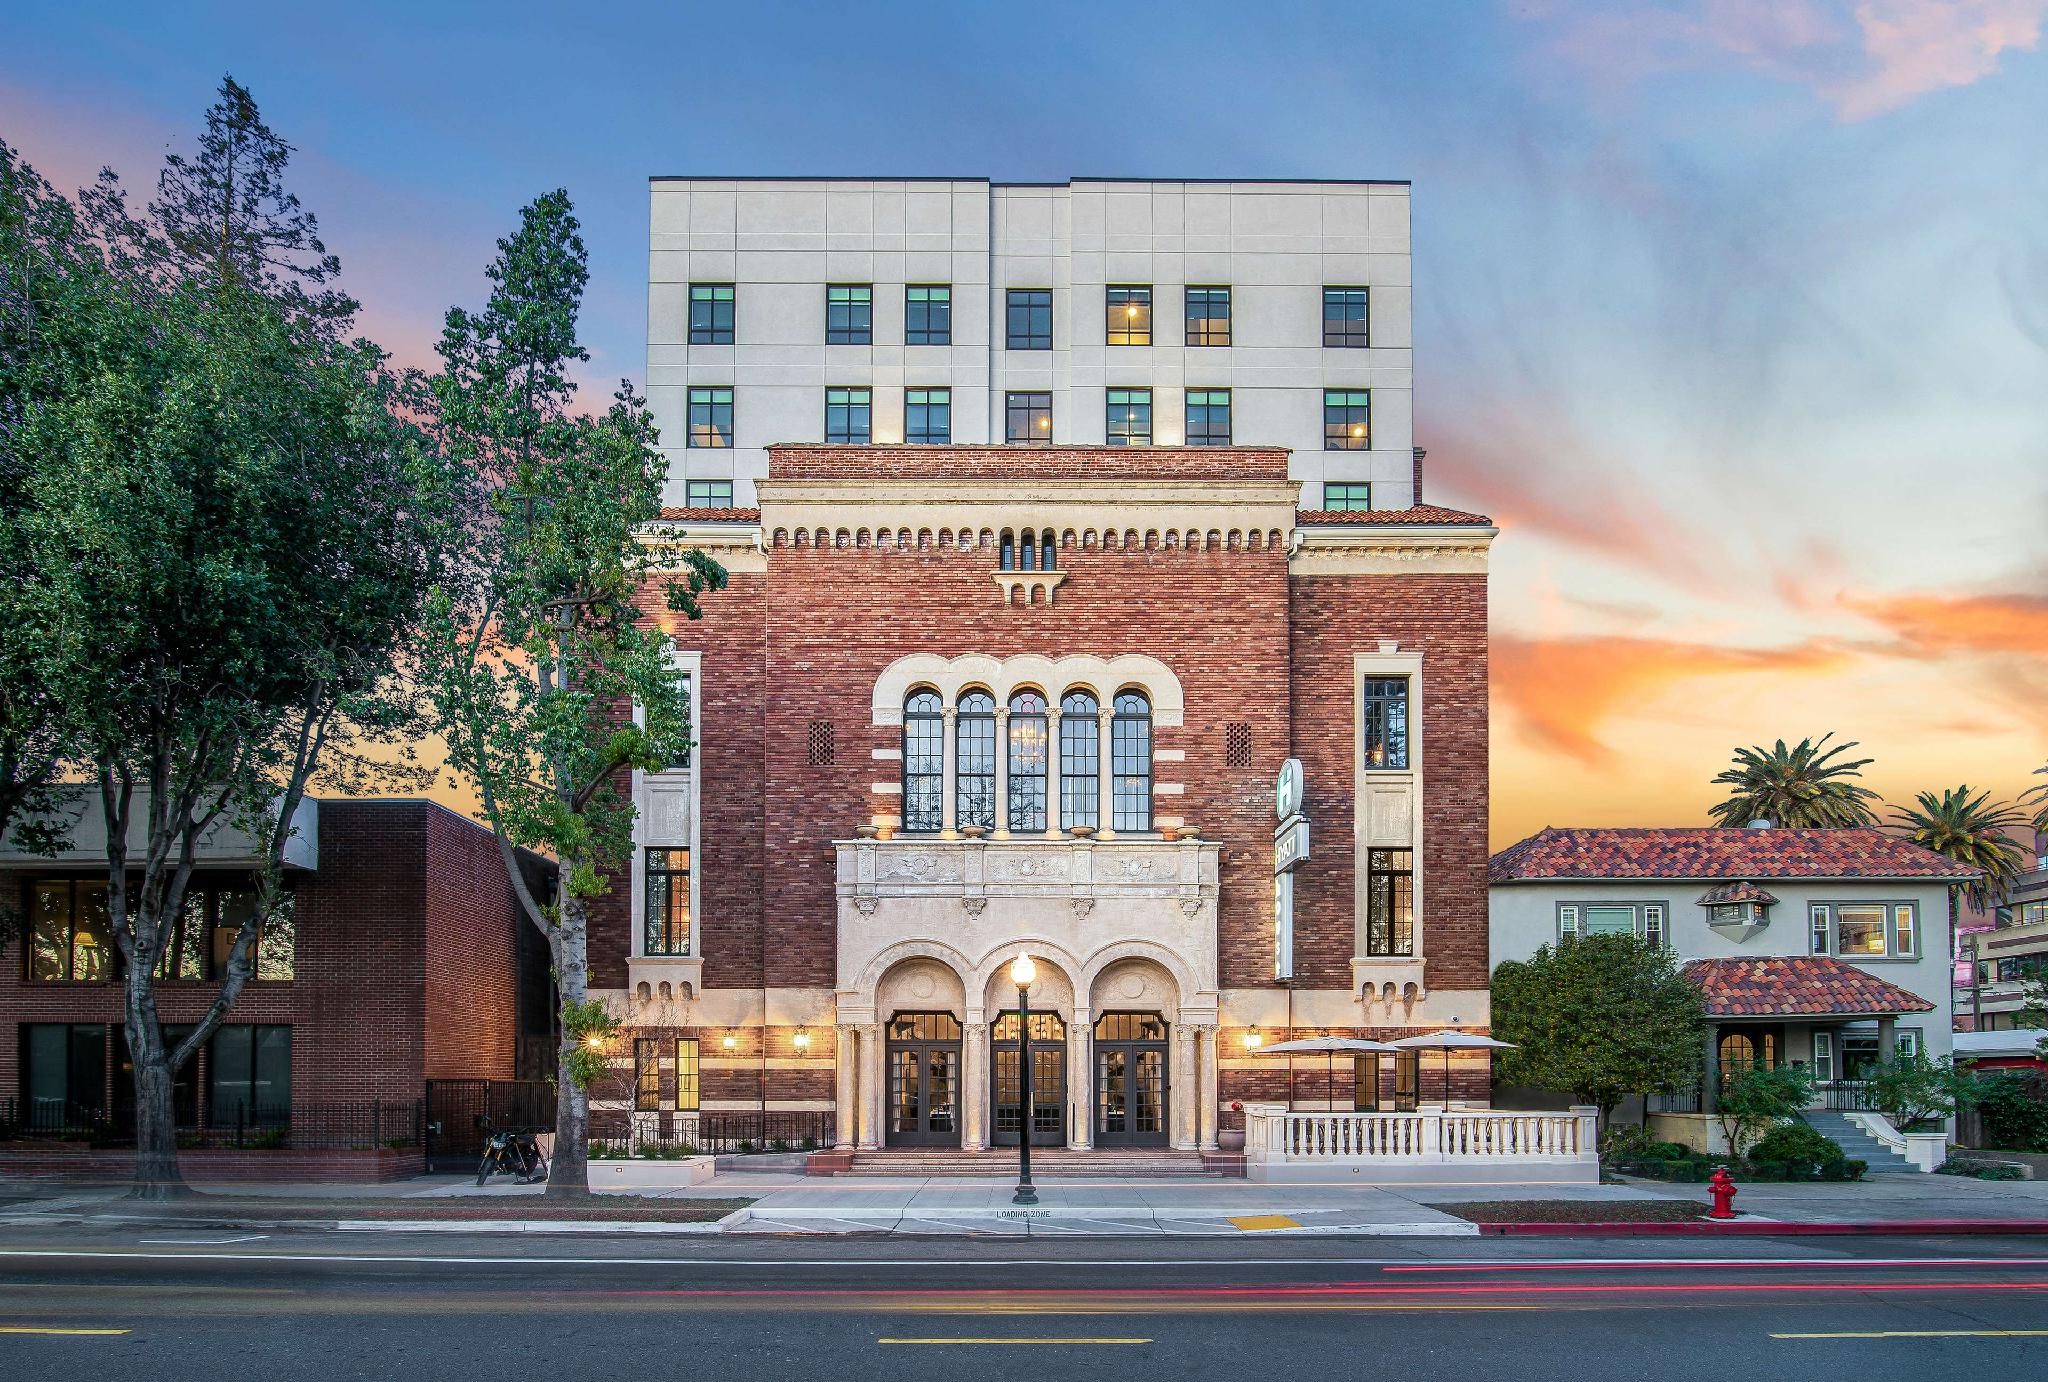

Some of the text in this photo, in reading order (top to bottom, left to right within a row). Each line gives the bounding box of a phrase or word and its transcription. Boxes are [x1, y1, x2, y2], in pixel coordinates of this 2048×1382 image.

[1279, 766, 1292, 813] H
[1274, 834, 1297, 865] HYATT
[996, 1210, 1051, 1218] LOADING ZONE
